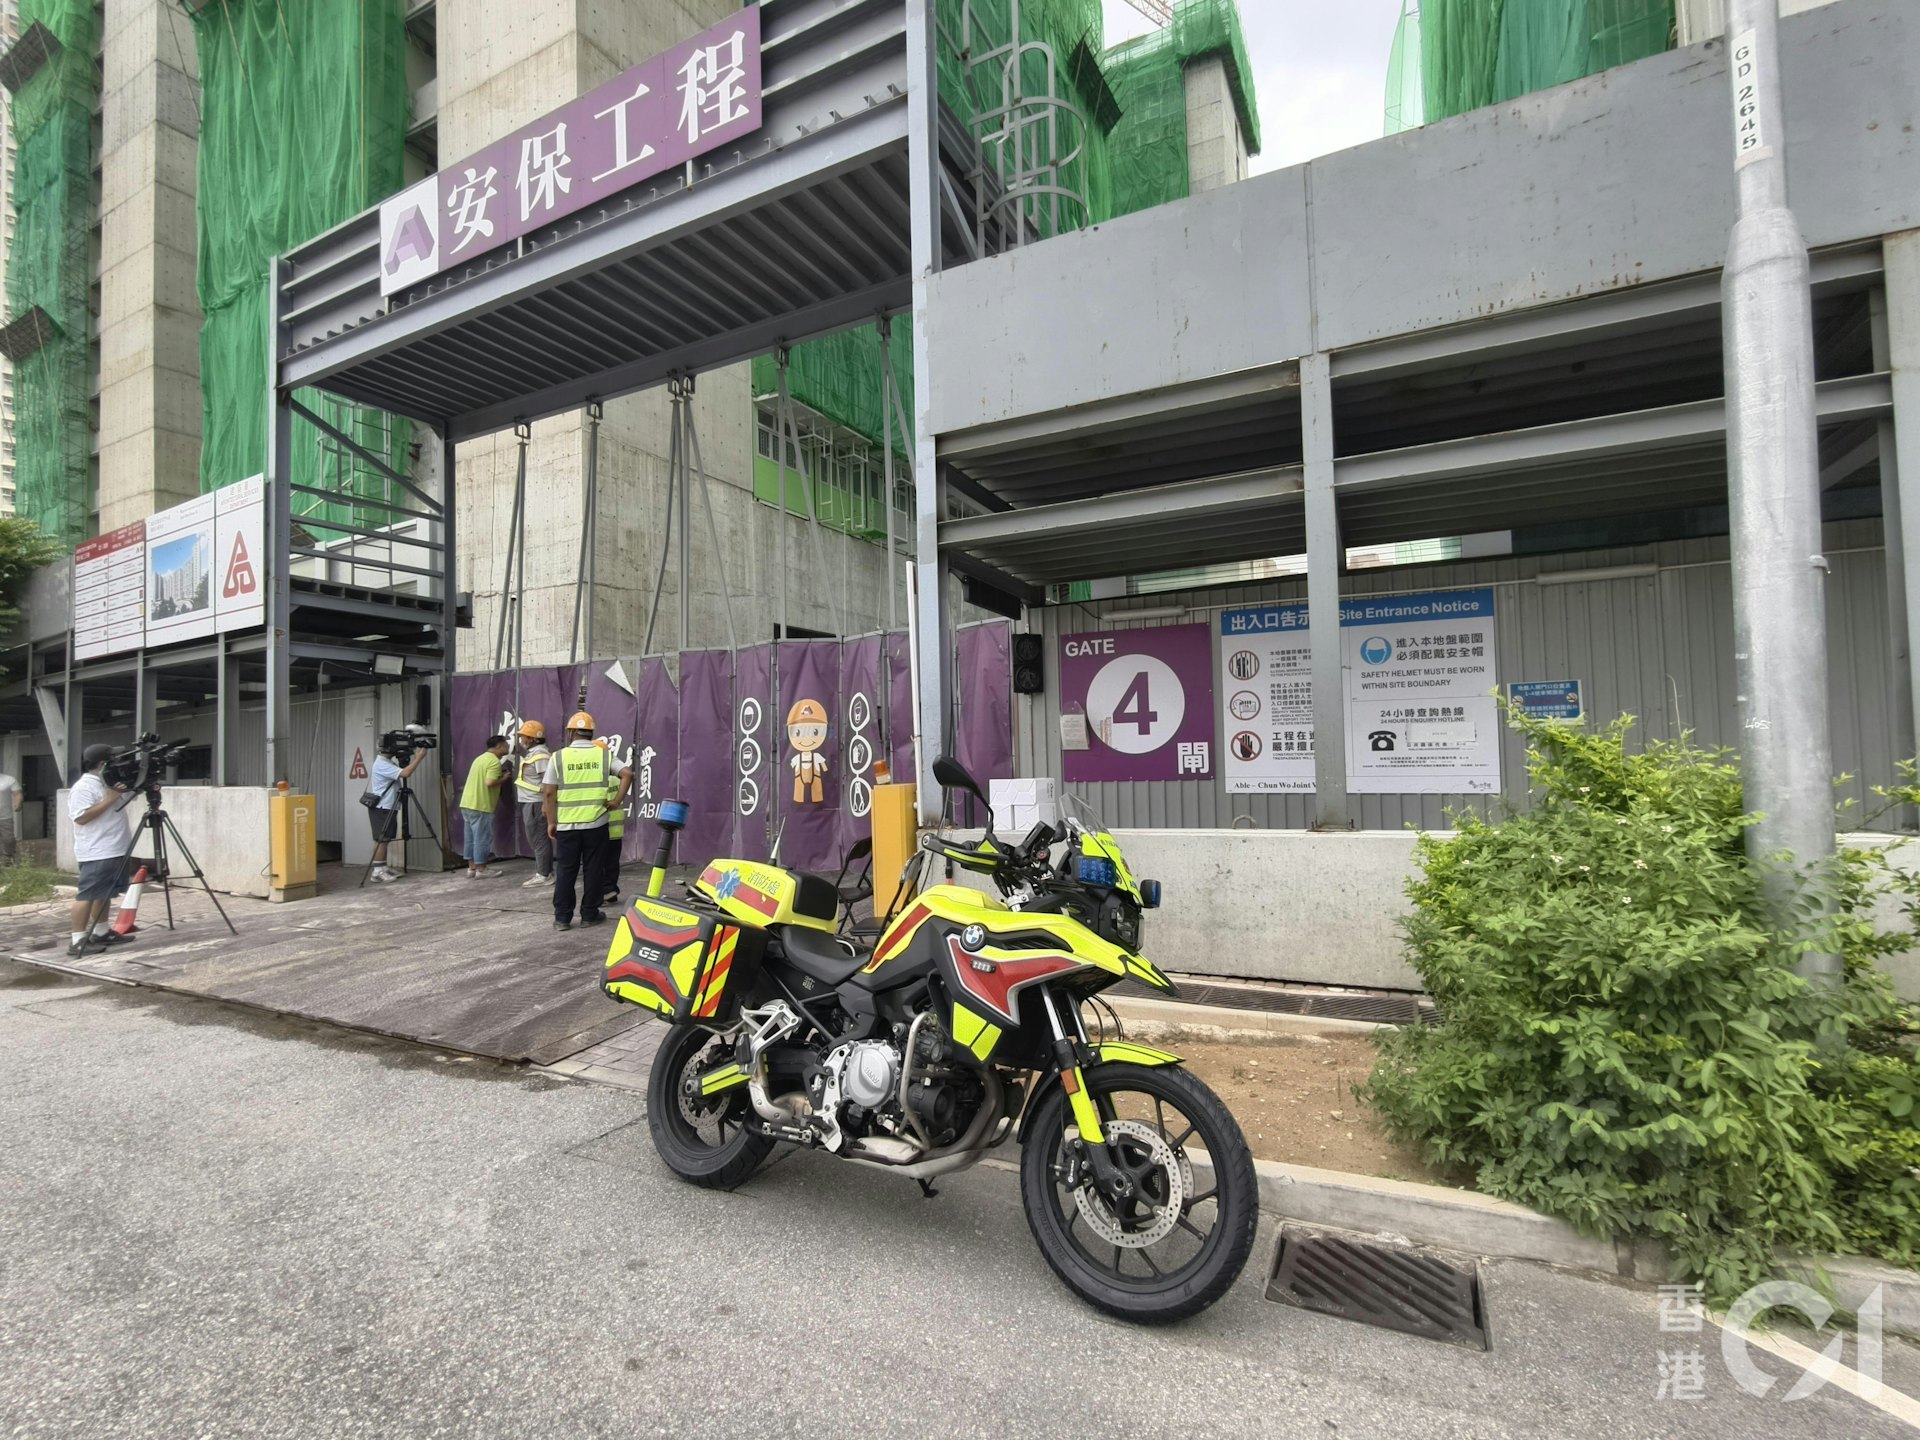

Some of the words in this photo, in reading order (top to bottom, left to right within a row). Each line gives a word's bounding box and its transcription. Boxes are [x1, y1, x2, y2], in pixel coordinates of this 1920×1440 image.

[1735, 46, 1751, 78] GD
[1739, 86, 1756, 149] 2645
[446, 30, 750, 255] 安保工程
[1339, 609, 1363, 621] Site
[1365, 605, 1429, 619] Entrance
[1432, 600, 1480, 614] Notice
[1065, 638, 1115, 658] GATE
[1396, 632, 1484, 648] 進入本地盤範圍
[1396, 646, 1484, 661] 必須配戴安全帽
[1361, 671, 1390, 679] SAFETY
[1391, 668, 1422, 677] HELMET
[1424, 667, 1446, 676] MUST
[1459, 665, 1485, 674] WORN
[1361, 682, 1388, 690] WITHIN
[1389, 681, 1406, 689] SITE
[1407, 679, 1451, 688] BOUNDARY
[1112, 671, 1158, 736] 4
[1177, 741, 1210, 775] 閘
[747, 870, 781, 895] 消防處
[638, 946, 660, 962] GS
